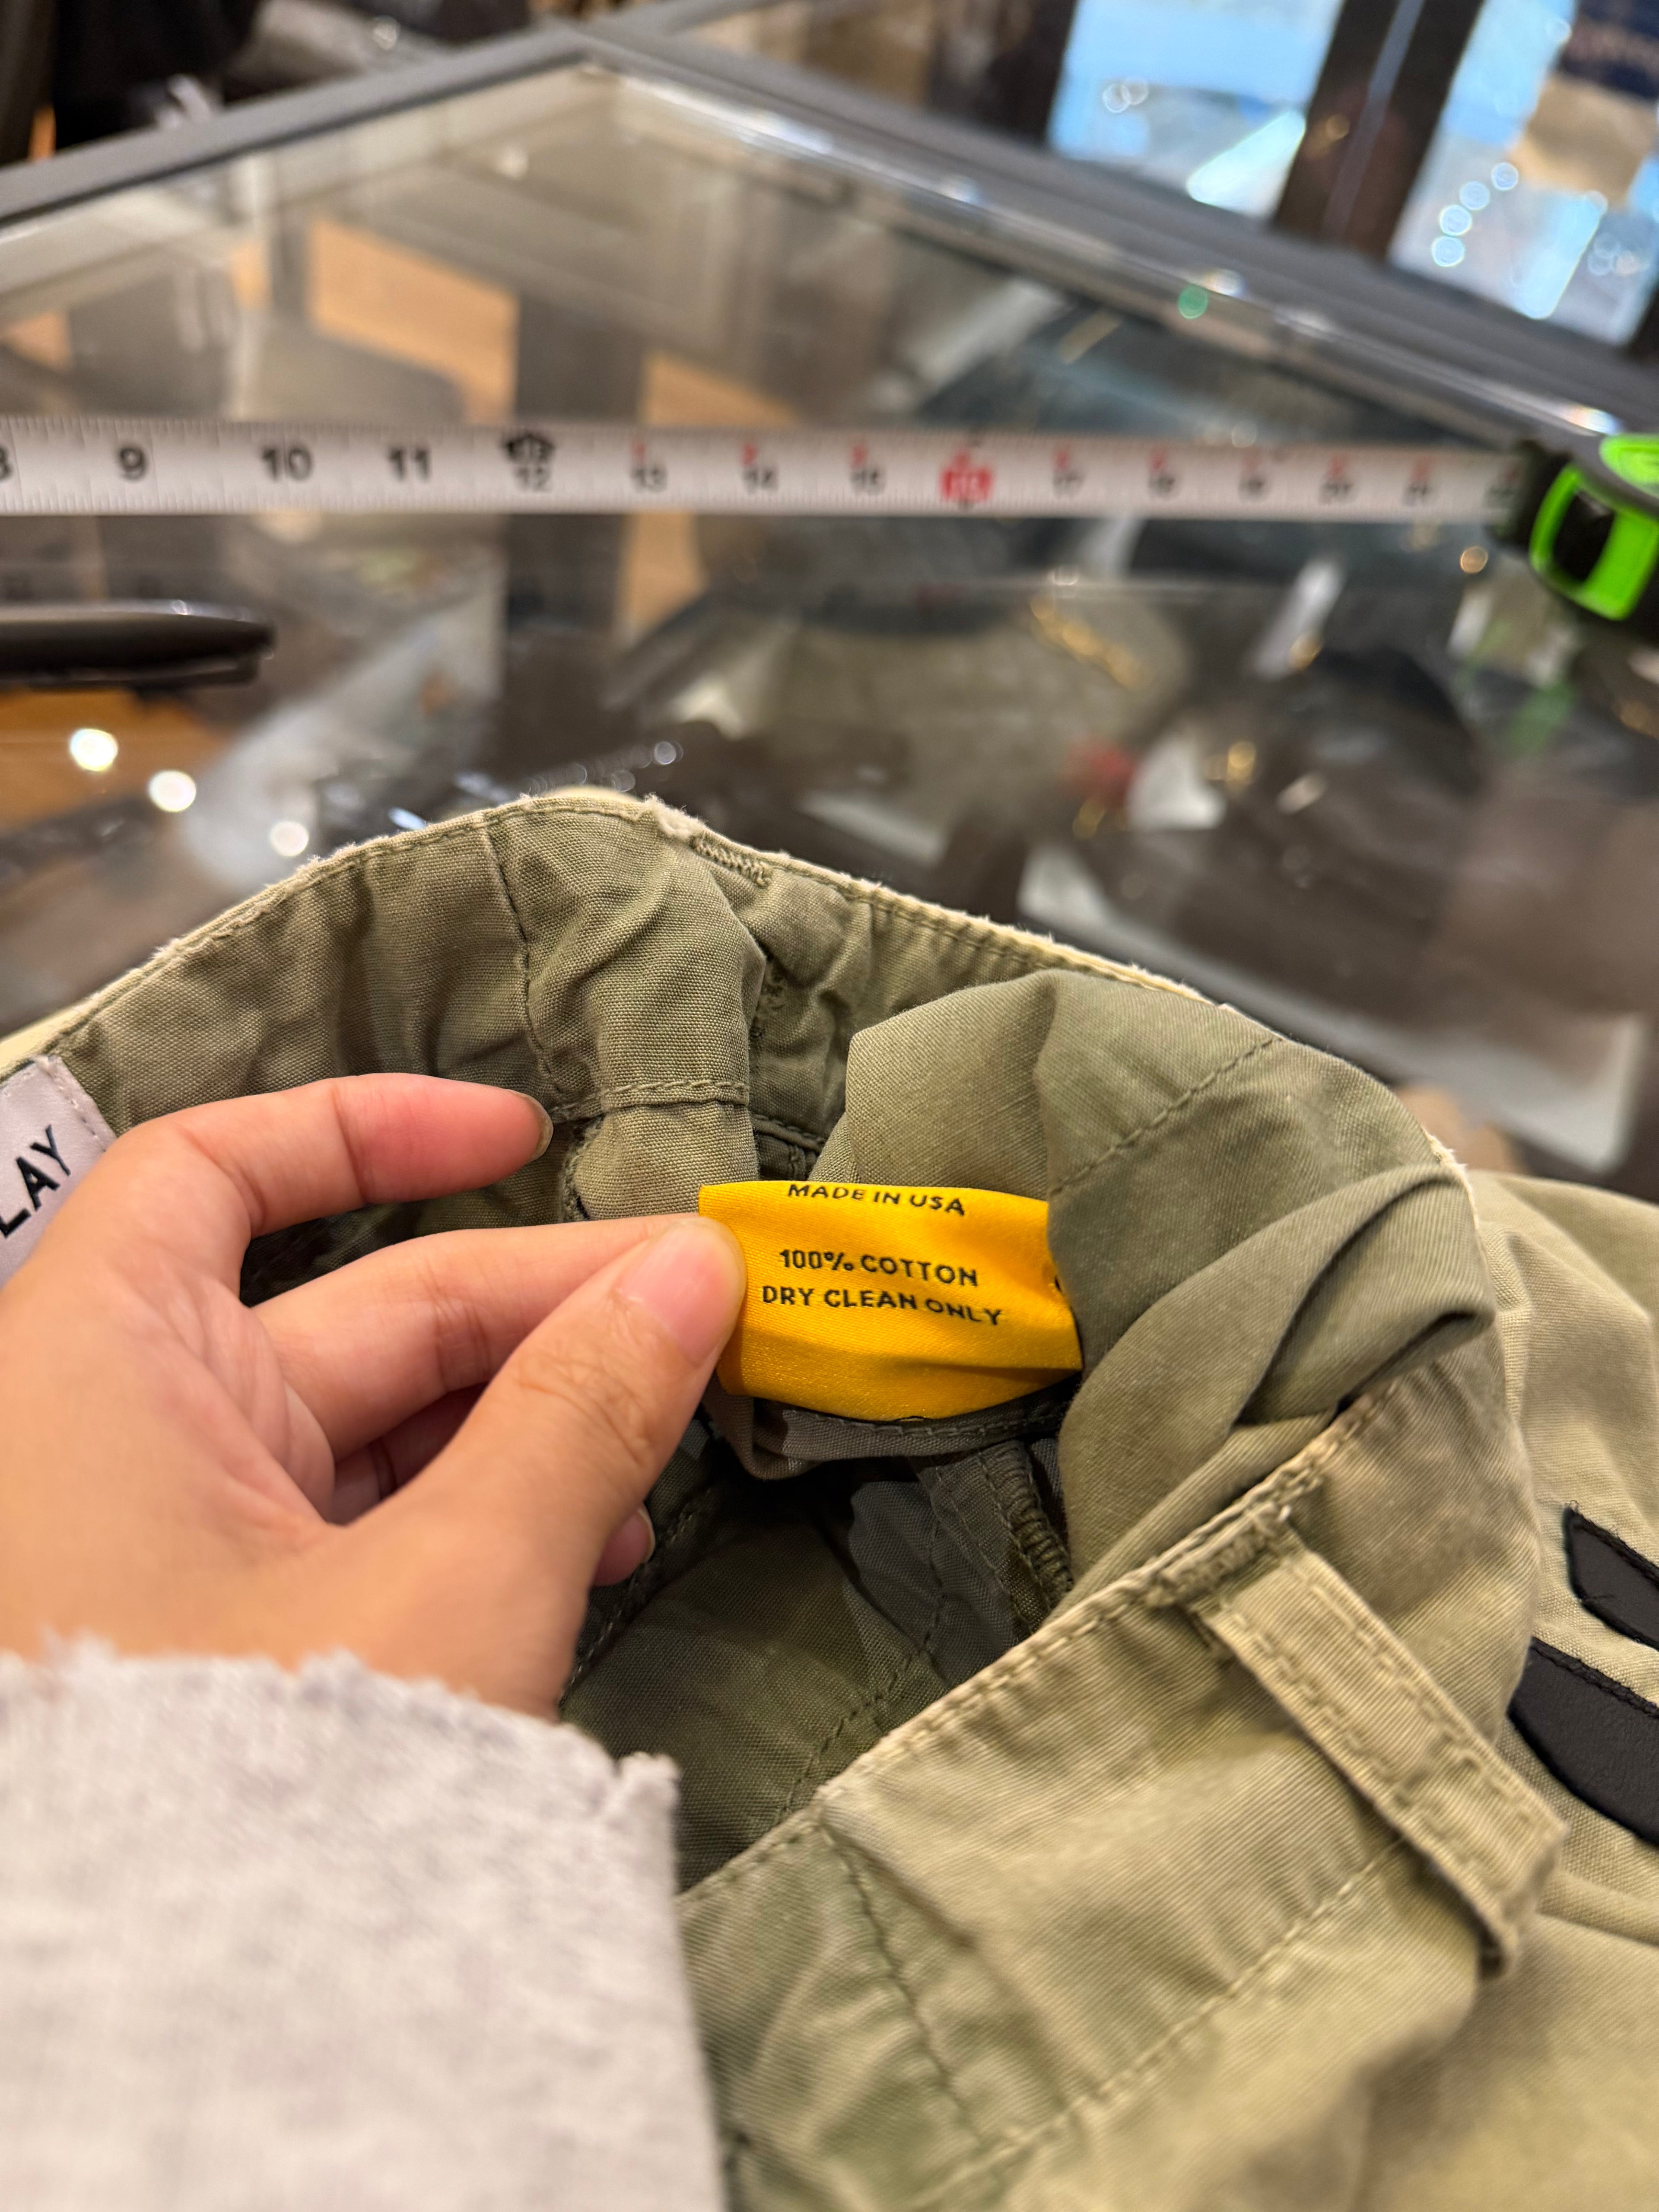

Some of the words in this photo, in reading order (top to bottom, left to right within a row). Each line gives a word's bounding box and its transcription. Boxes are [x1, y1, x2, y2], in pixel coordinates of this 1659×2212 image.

[118, 446, 147, 482] 9
[261, 448, 314, 483] 10
[389, 448, 431, 483] 11
[788, 1184, 865, 1201] MADE
[874, 1191, 900, 1205] IN
[909, 1194, 965, 1217] USA
[779, 1249, 854, 1271] 100%
[860, 1255, 978, 1287] COTTON
[762, 1286, 815, 1306] DRY
[823, 1289, 918, 1310] CLEAN
[925, 1298, 1003, 1325] ONLY
